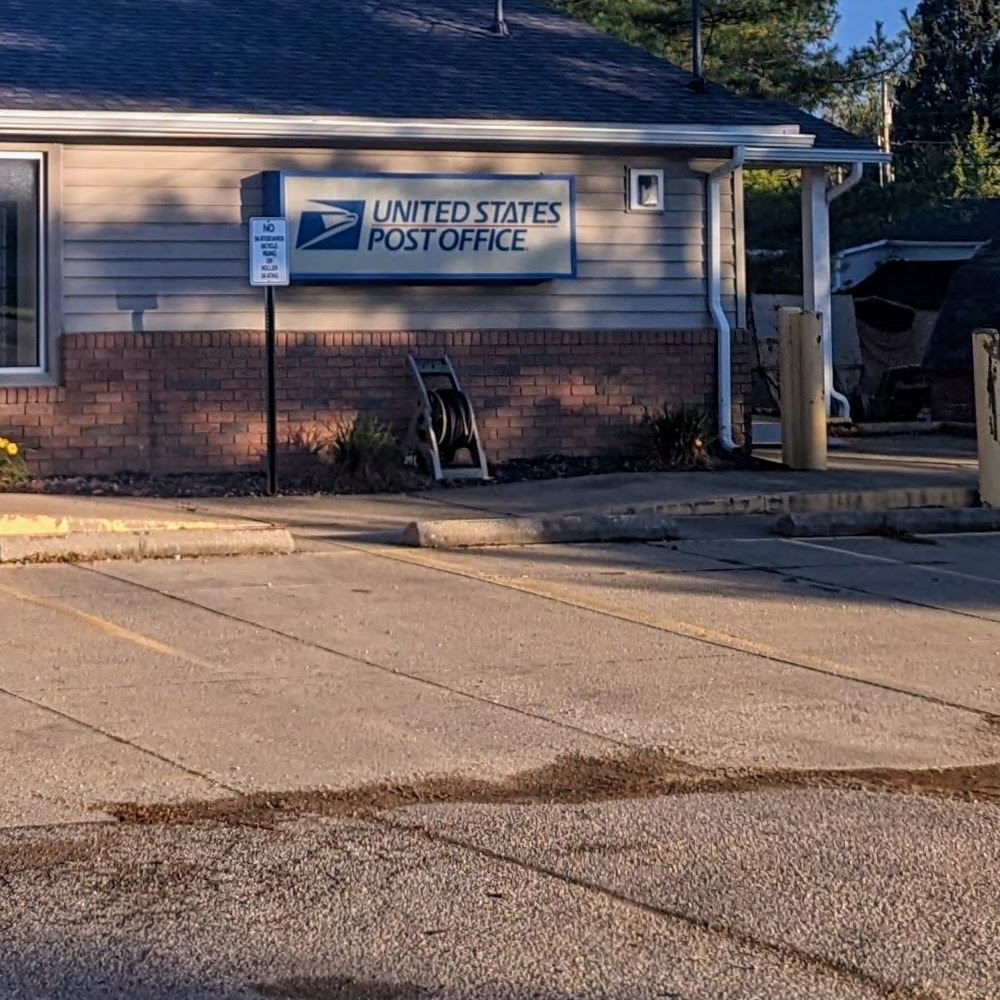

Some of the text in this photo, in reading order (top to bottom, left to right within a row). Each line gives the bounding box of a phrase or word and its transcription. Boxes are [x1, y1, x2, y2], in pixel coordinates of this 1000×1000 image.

[373, 200, 562, 224] UNITED STATES
[262, 223, 275, 233] NO
[367, 228, 528, 251] POST OFFICE
